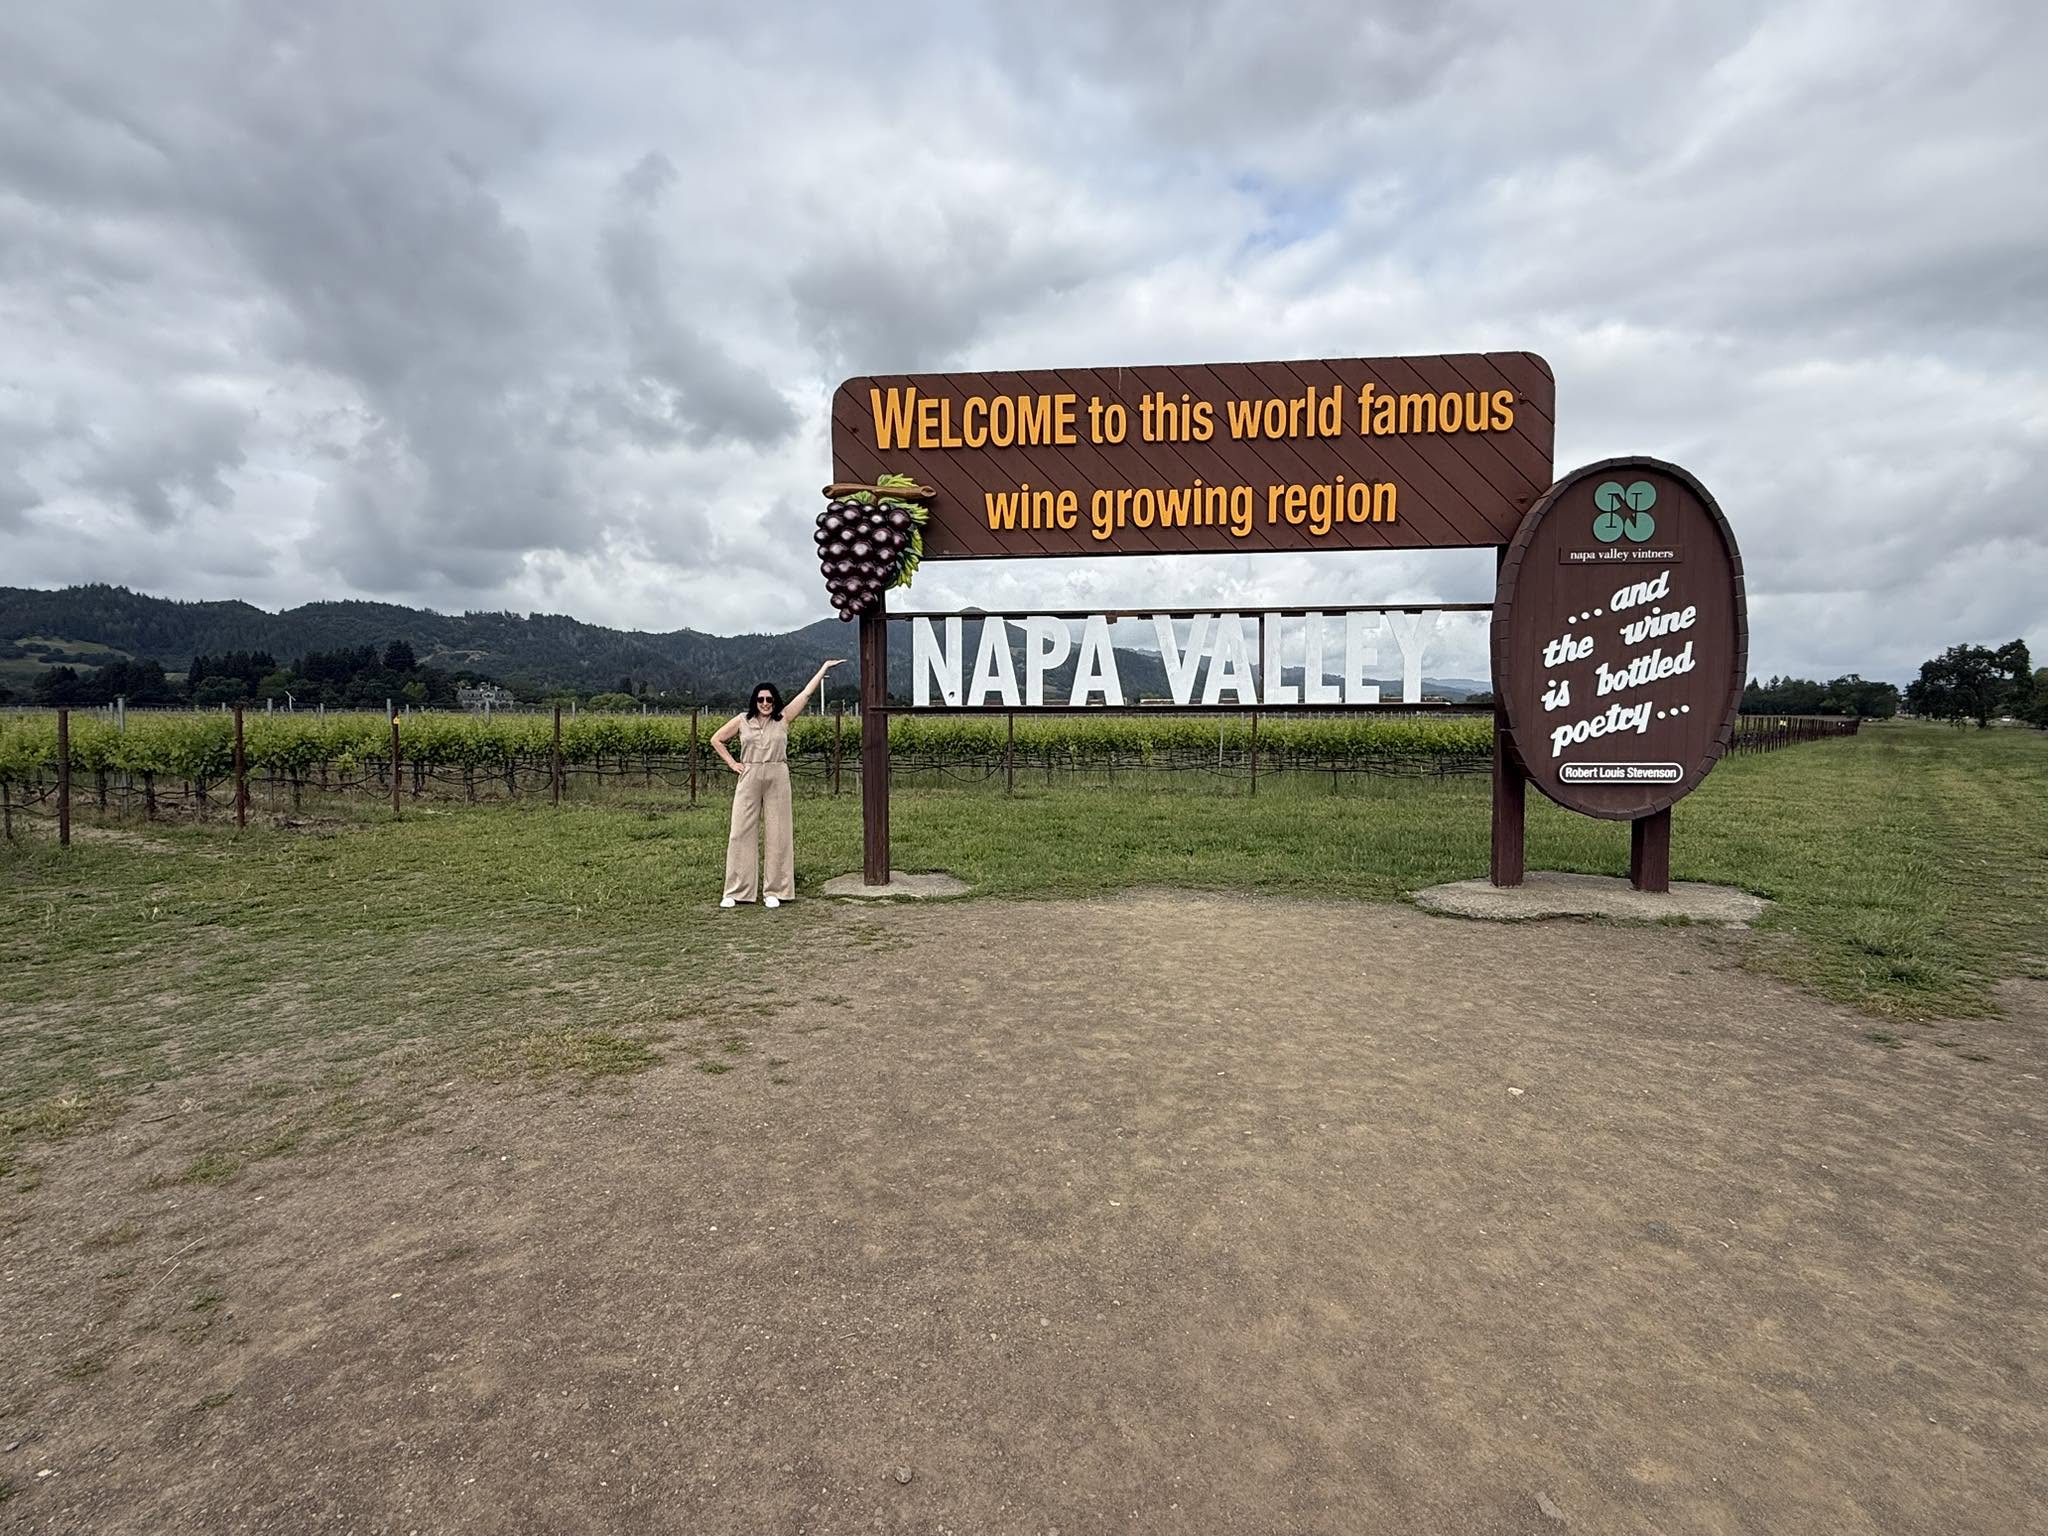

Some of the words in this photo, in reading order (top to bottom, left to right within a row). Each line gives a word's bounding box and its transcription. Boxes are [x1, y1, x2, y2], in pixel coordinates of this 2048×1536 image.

[870, 386, 1077, 449] WELCOME
[1089, 398, 1127, 443] to
[1140, 393, 1214, 441] this
[1227, 384, 1343, 439] world
[1359, 383, 1514, 435] famous
[985, 484, 1078, 529] wine
[1091, 479, 1253, 540] growing
[1268, 475, 1397, 536] region
[1570, 551, 1596, 562] napa
[1598, 548, 1629, 562] valley
[1632, 548, 1674, 560] vintners
[911, 613, 1125, 707] NAPA
[1152, 609, 1443, 704] VALLEY
[1542, 633, 1594, 669] the
[1619, 605, 1697, 645] wine
[1540, 679, 1571, 712] is
[1594, 641, 1696, 697] bottled
[1565, 766, 1599, 778] Robert
[1599, 766, 1626, 778] Louis
[1626, 766, 1677, 779] Stevenson
